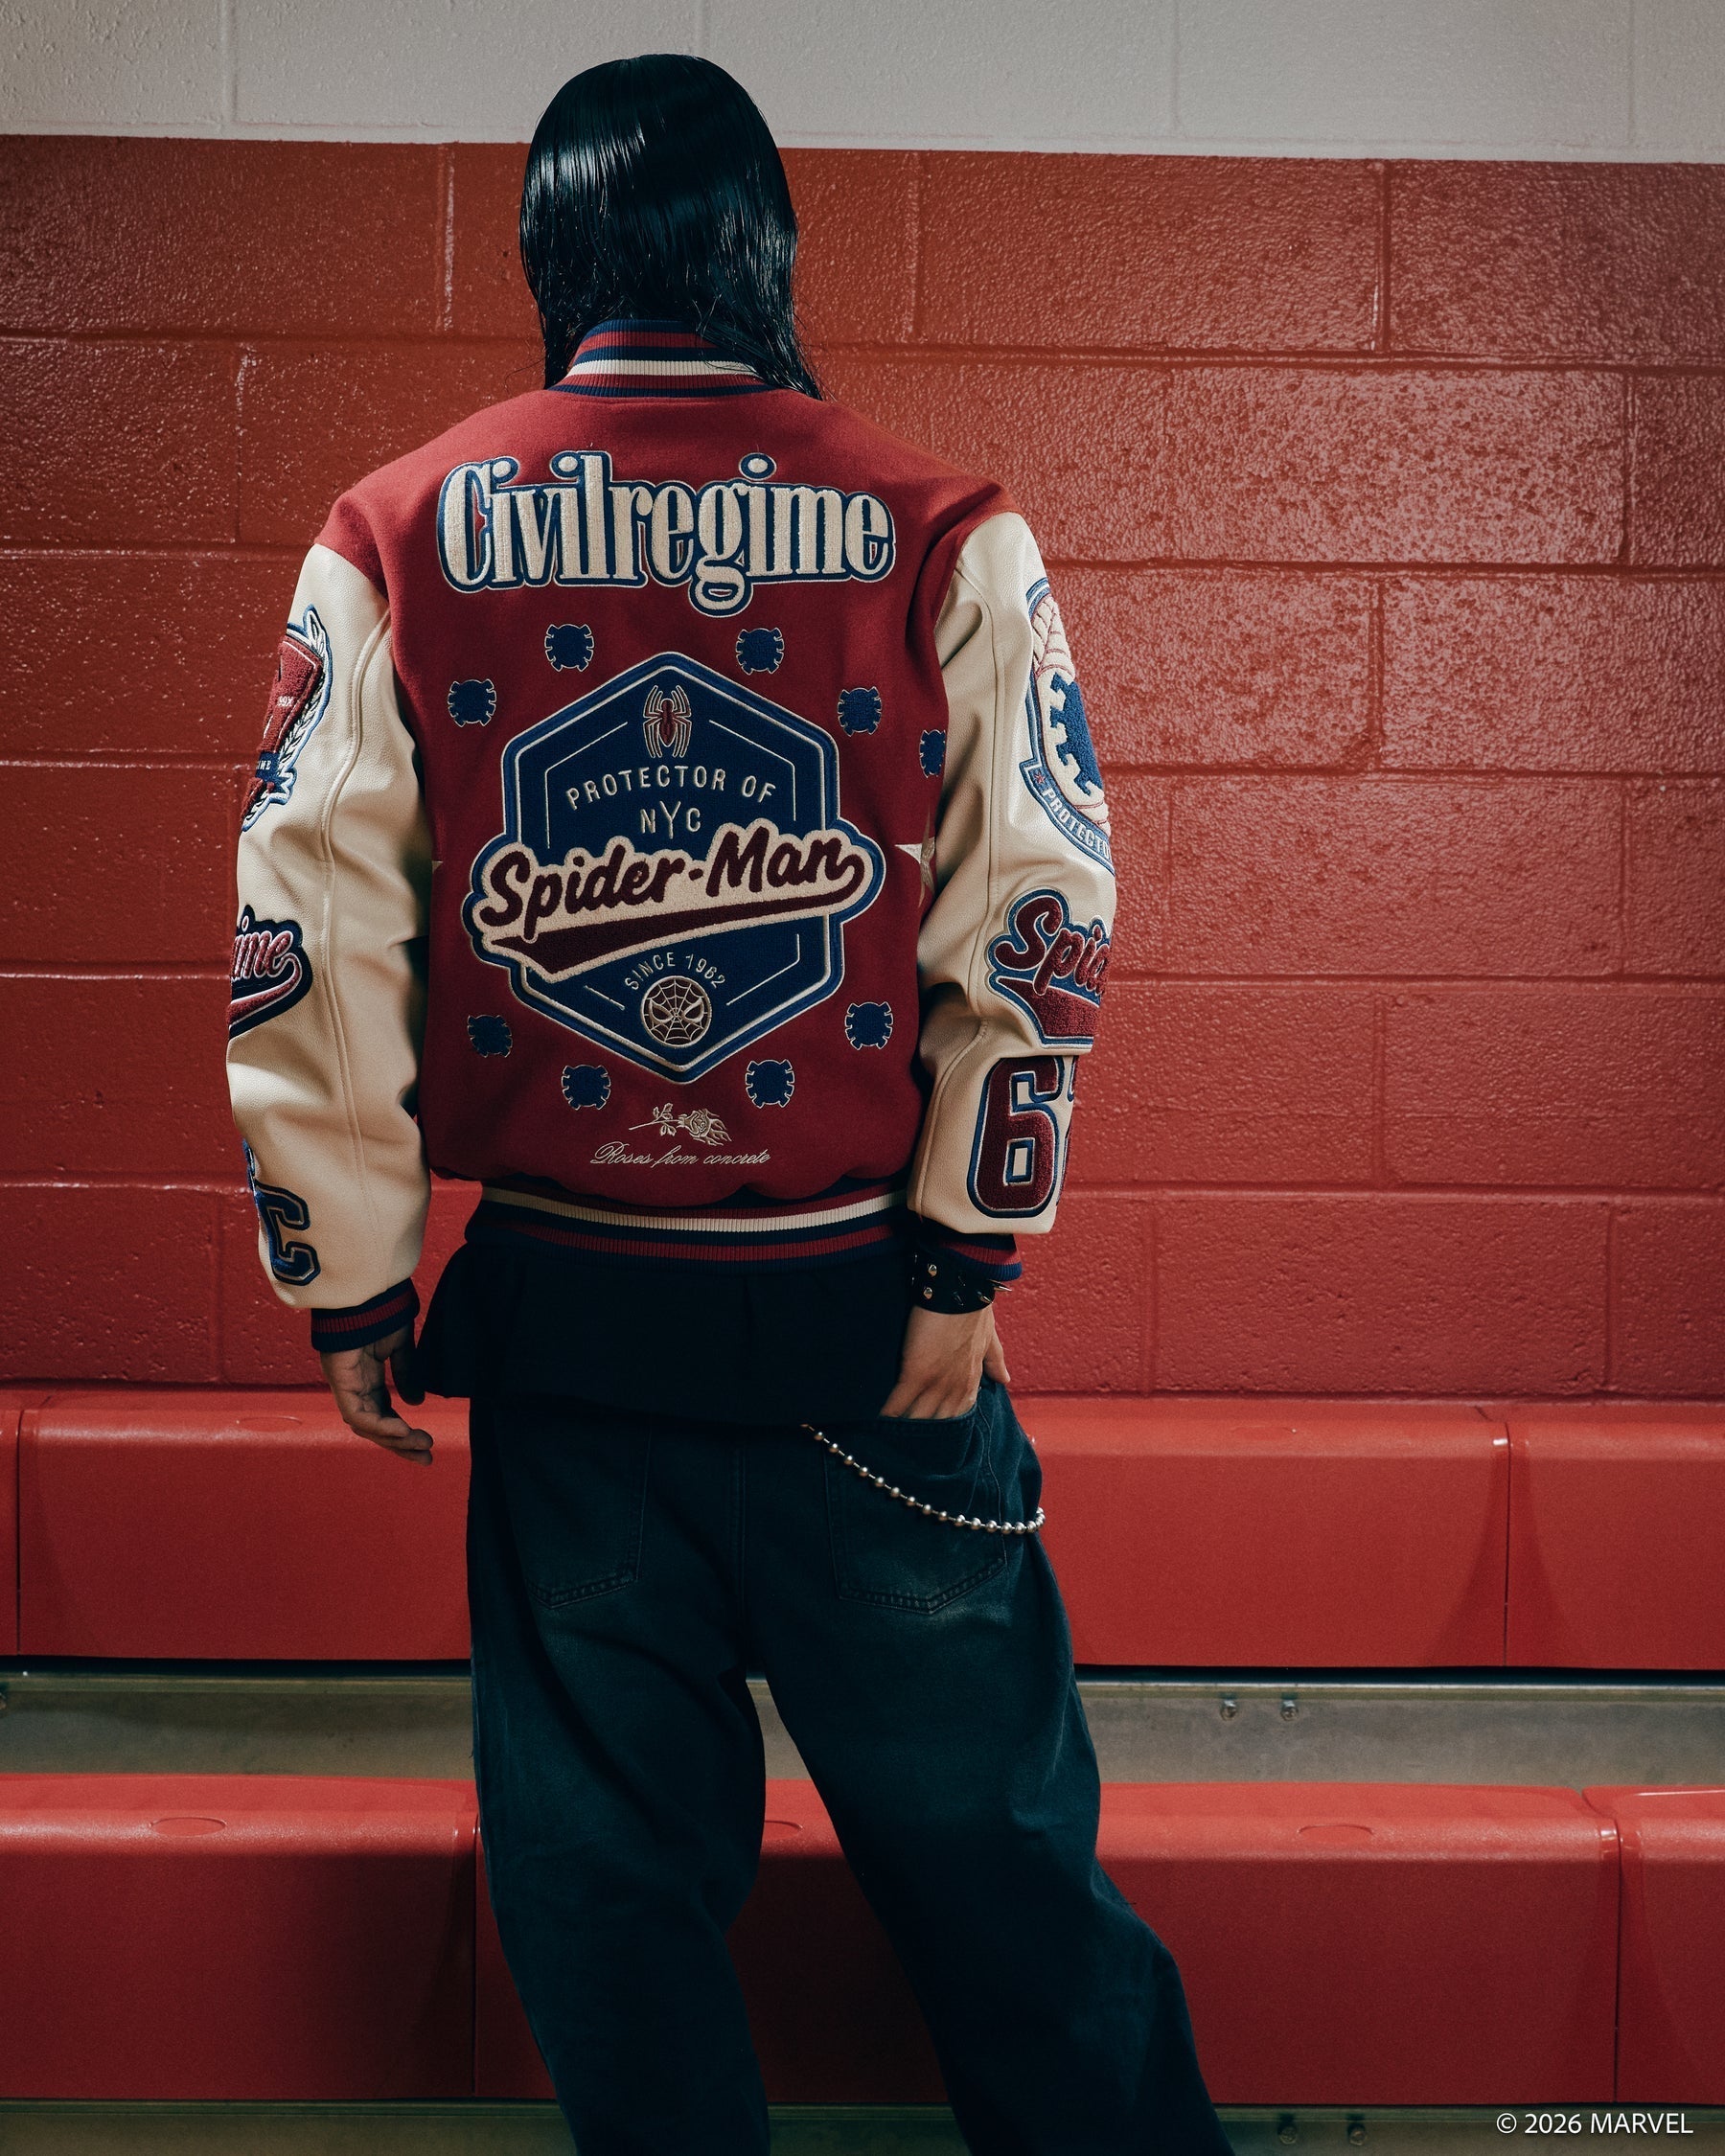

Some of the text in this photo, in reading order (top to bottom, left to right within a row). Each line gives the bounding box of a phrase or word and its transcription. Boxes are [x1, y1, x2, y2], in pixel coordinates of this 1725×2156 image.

[440, 452, 892, 615] Civilregime
[565, 765, 776, 811] PROTECTOR OF
[639, 800, 702, 839] NYC
[477, 823, 860, 943] Spider-Man
[624, 952, 726, 991] SINCE 1962
[589, 1140, 771, 1169] Roses from concrete
[967, 1055, 1077, 1219] 6
